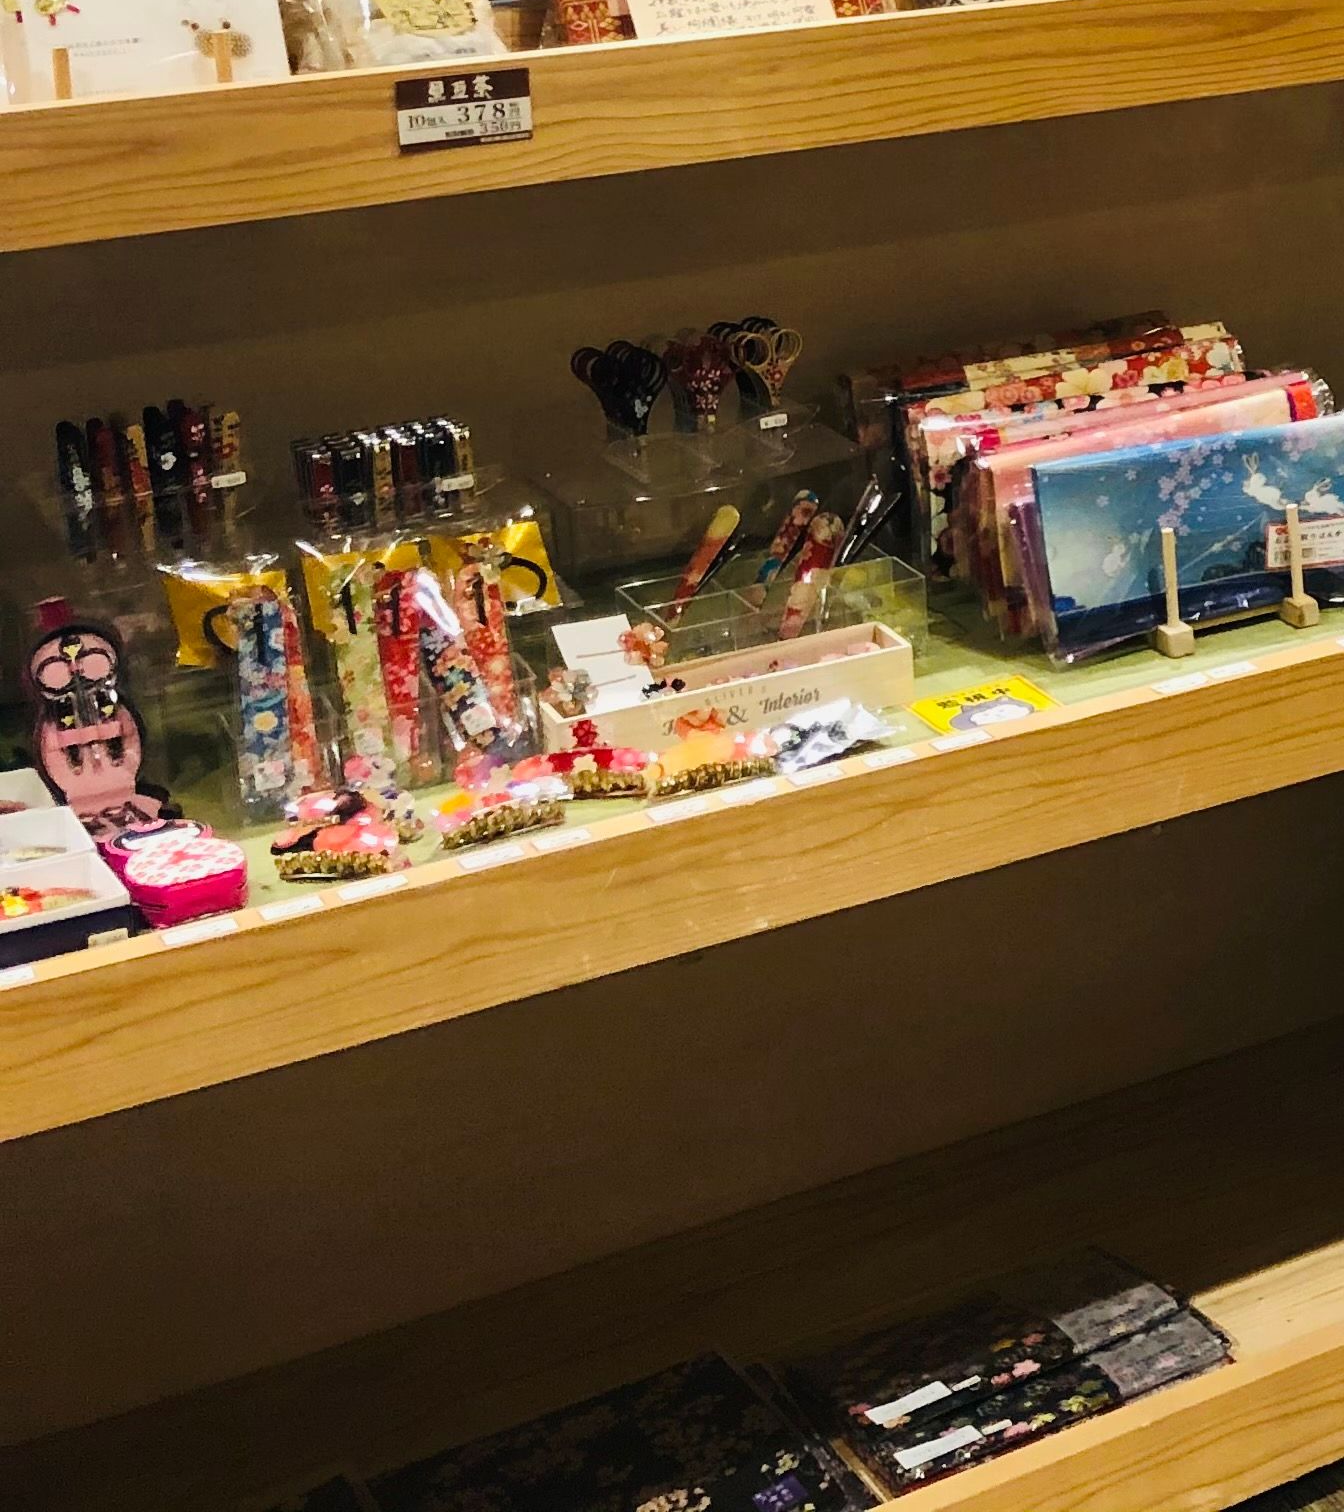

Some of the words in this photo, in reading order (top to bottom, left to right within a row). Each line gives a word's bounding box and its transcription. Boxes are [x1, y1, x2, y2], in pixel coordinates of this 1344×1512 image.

[428, 74, 494, 104] 黒豆茶
[759, 687, 820, 715] Interior
